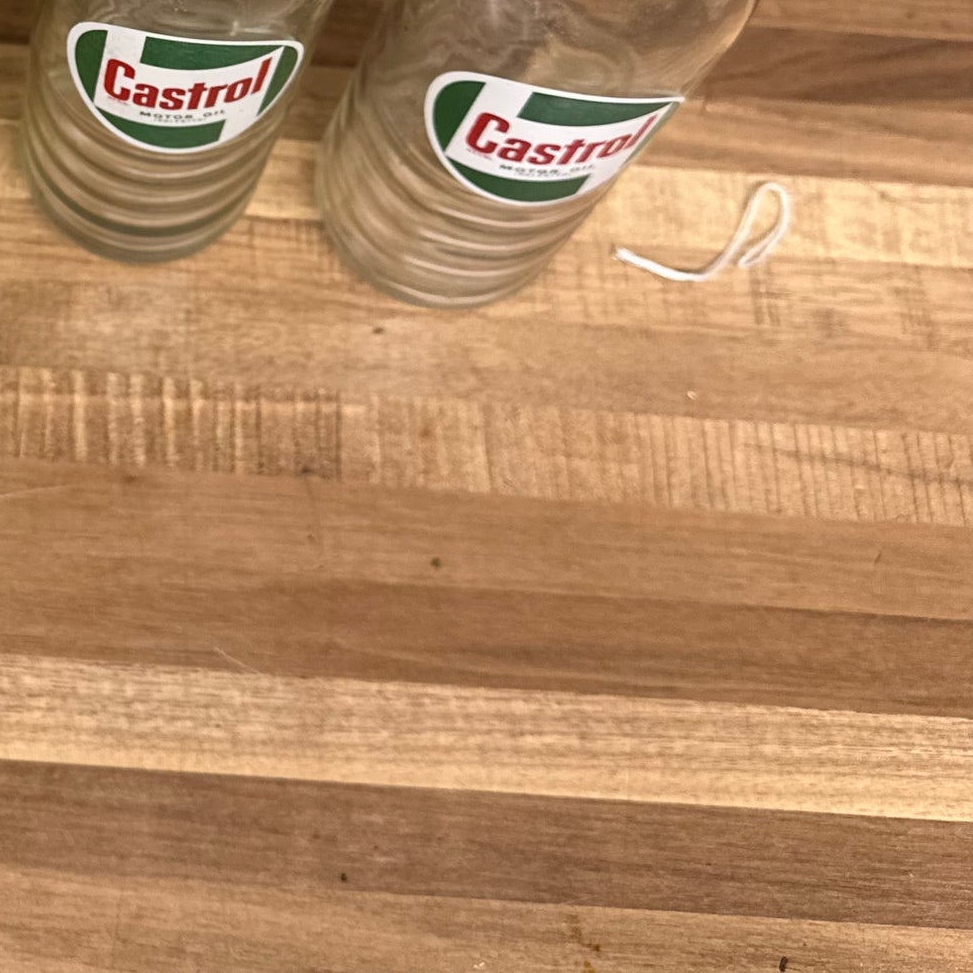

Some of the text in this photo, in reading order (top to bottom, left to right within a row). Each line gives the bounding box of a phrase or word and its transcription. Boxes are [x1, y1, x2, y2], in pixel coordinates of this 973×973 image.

[103, 56, 273, 111] Castrol
[138, 110, 194, 121] MOTOR
[202, 109, 227, 119] OIL
[464, 111, 659, 166] Castrol
[498, 163, 562, 175] MOTOR
